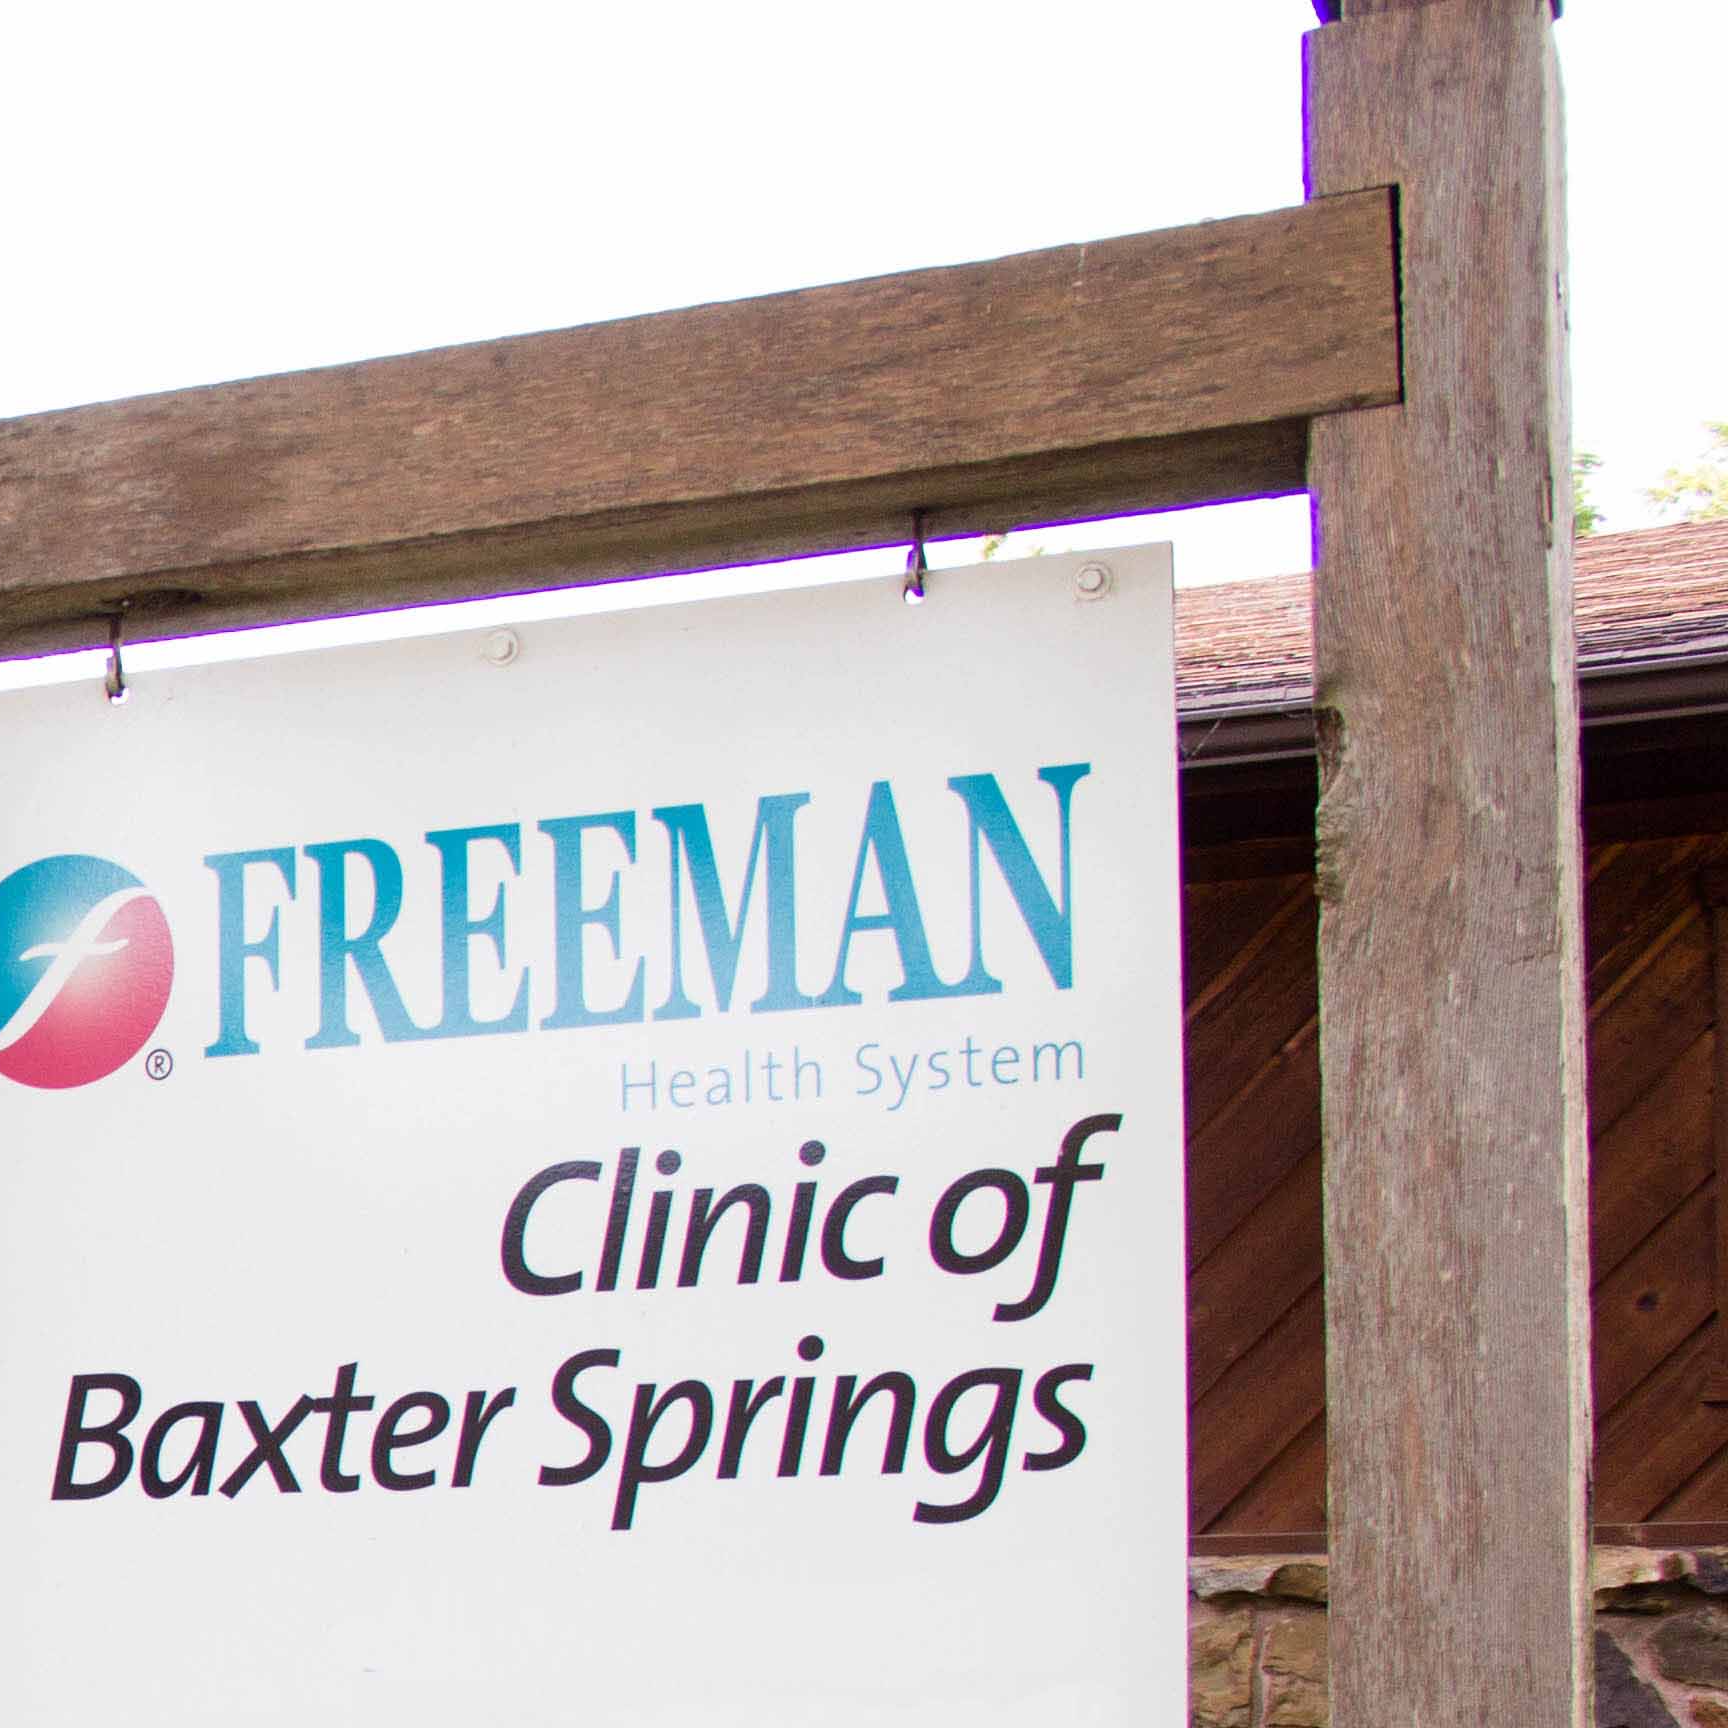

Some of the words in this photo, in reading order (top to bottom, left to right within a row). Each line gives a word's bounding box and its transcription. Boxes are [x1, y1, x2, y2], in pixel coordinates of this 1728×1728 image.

[204, 763, 1091, 1060] FREEMAN
[620, 1045, 823, 1112] Health
[855, 1036, 1085, 1111] System
[501, 1141, 899, 1296] Clinic
[929, 1113, 1123, 1322] of
[51, 1362, 516, 1501] Baxter
[539, 1336, 1093, 1531] Springs
